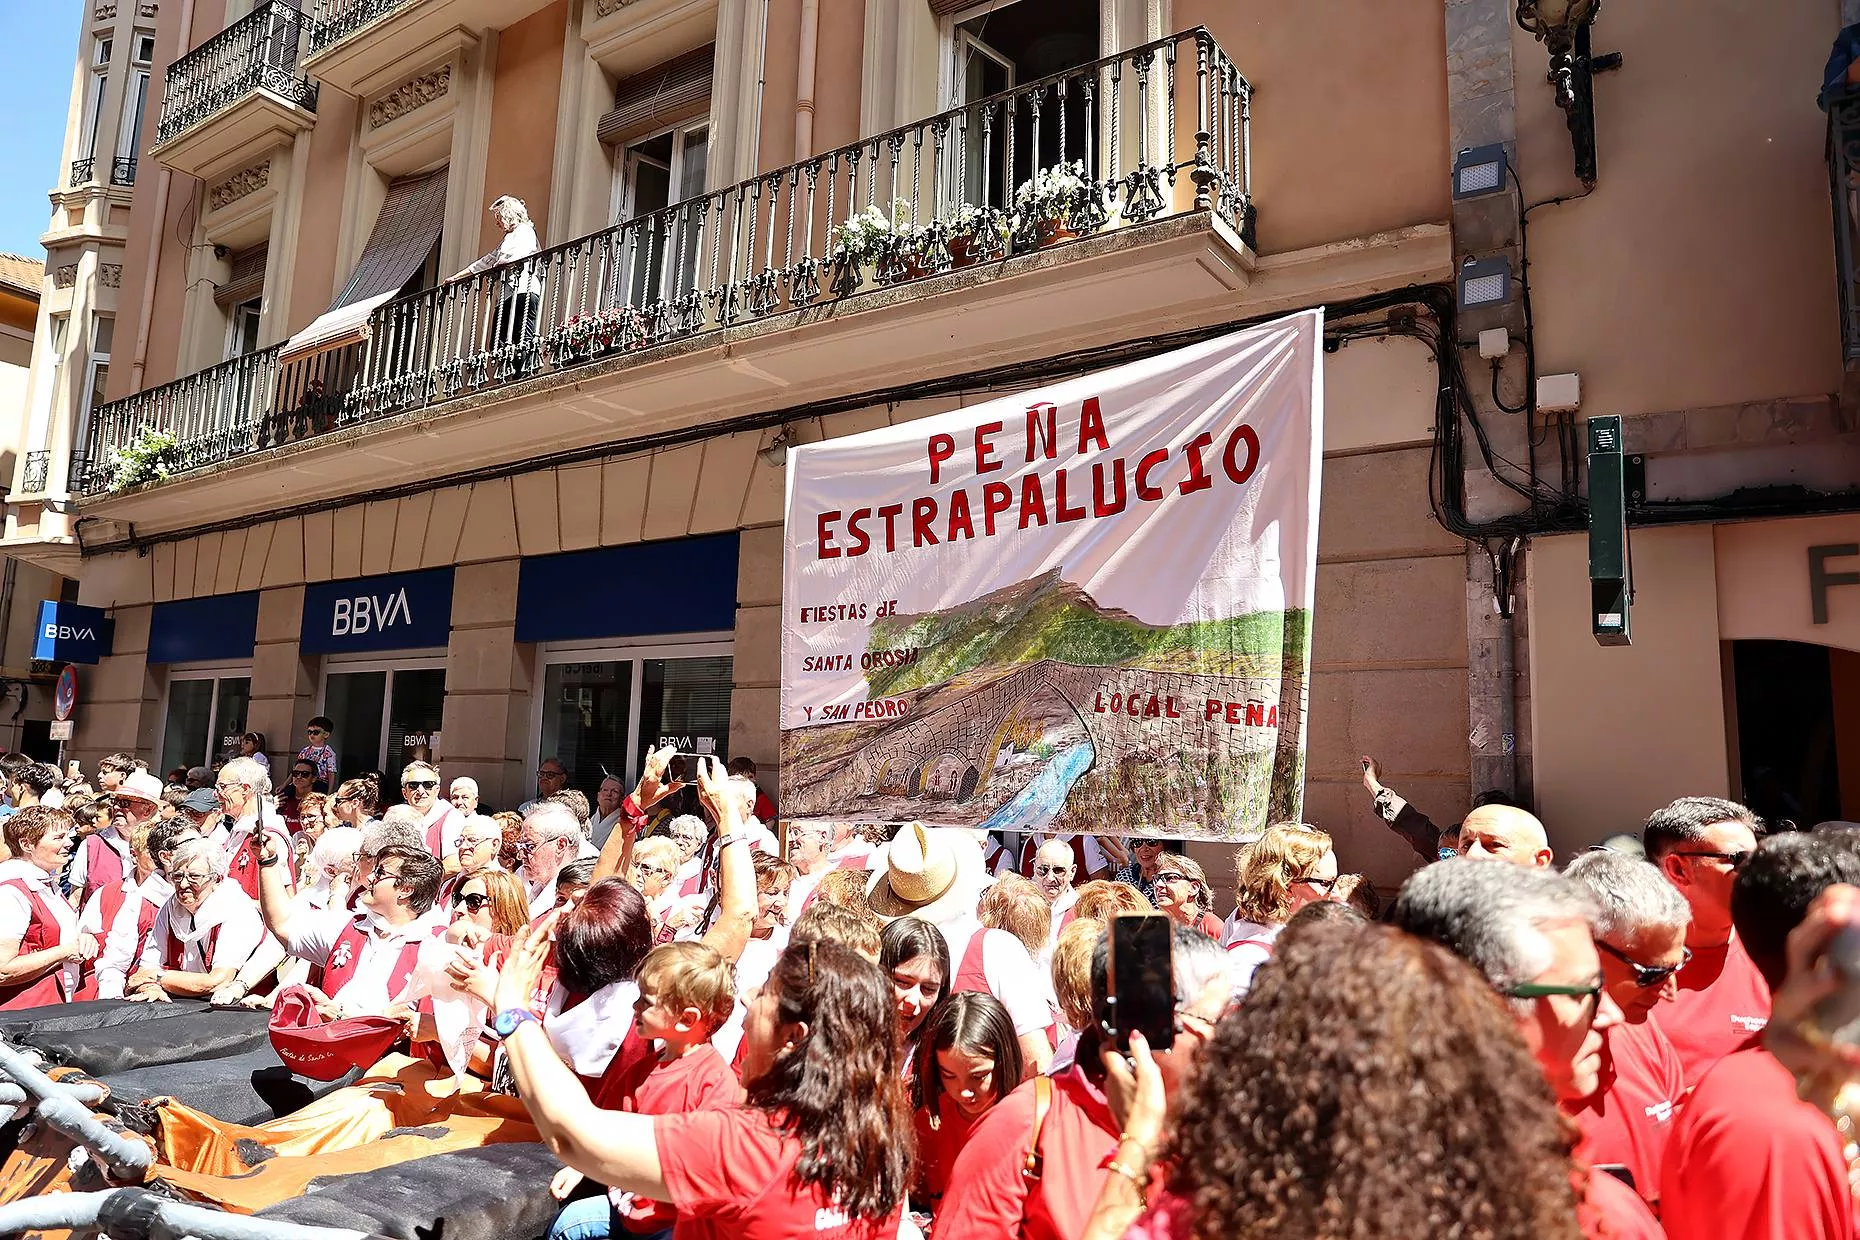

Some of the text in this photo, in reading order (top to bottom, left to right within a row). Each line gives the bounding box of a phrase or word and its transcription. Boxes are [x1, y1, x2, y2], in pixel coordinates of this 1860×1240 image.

[928, 397, 1110, 484] PEÑA
[818, 424, 1260, 559] ESTRAPALUCIO
[333, 587, 412, 636] BBVA
[800, 603, 867, 623] FIESTAS
[44, 624, 96, 641] BBVA
[802, 647, 918, 671] SANTA OROSIA
[803, 699, 908, 721] Y SAN PEDRO
[1094, 692, 1277, 728] LOCAL PEÑA
[404, 734, 427, 746] BBVA
